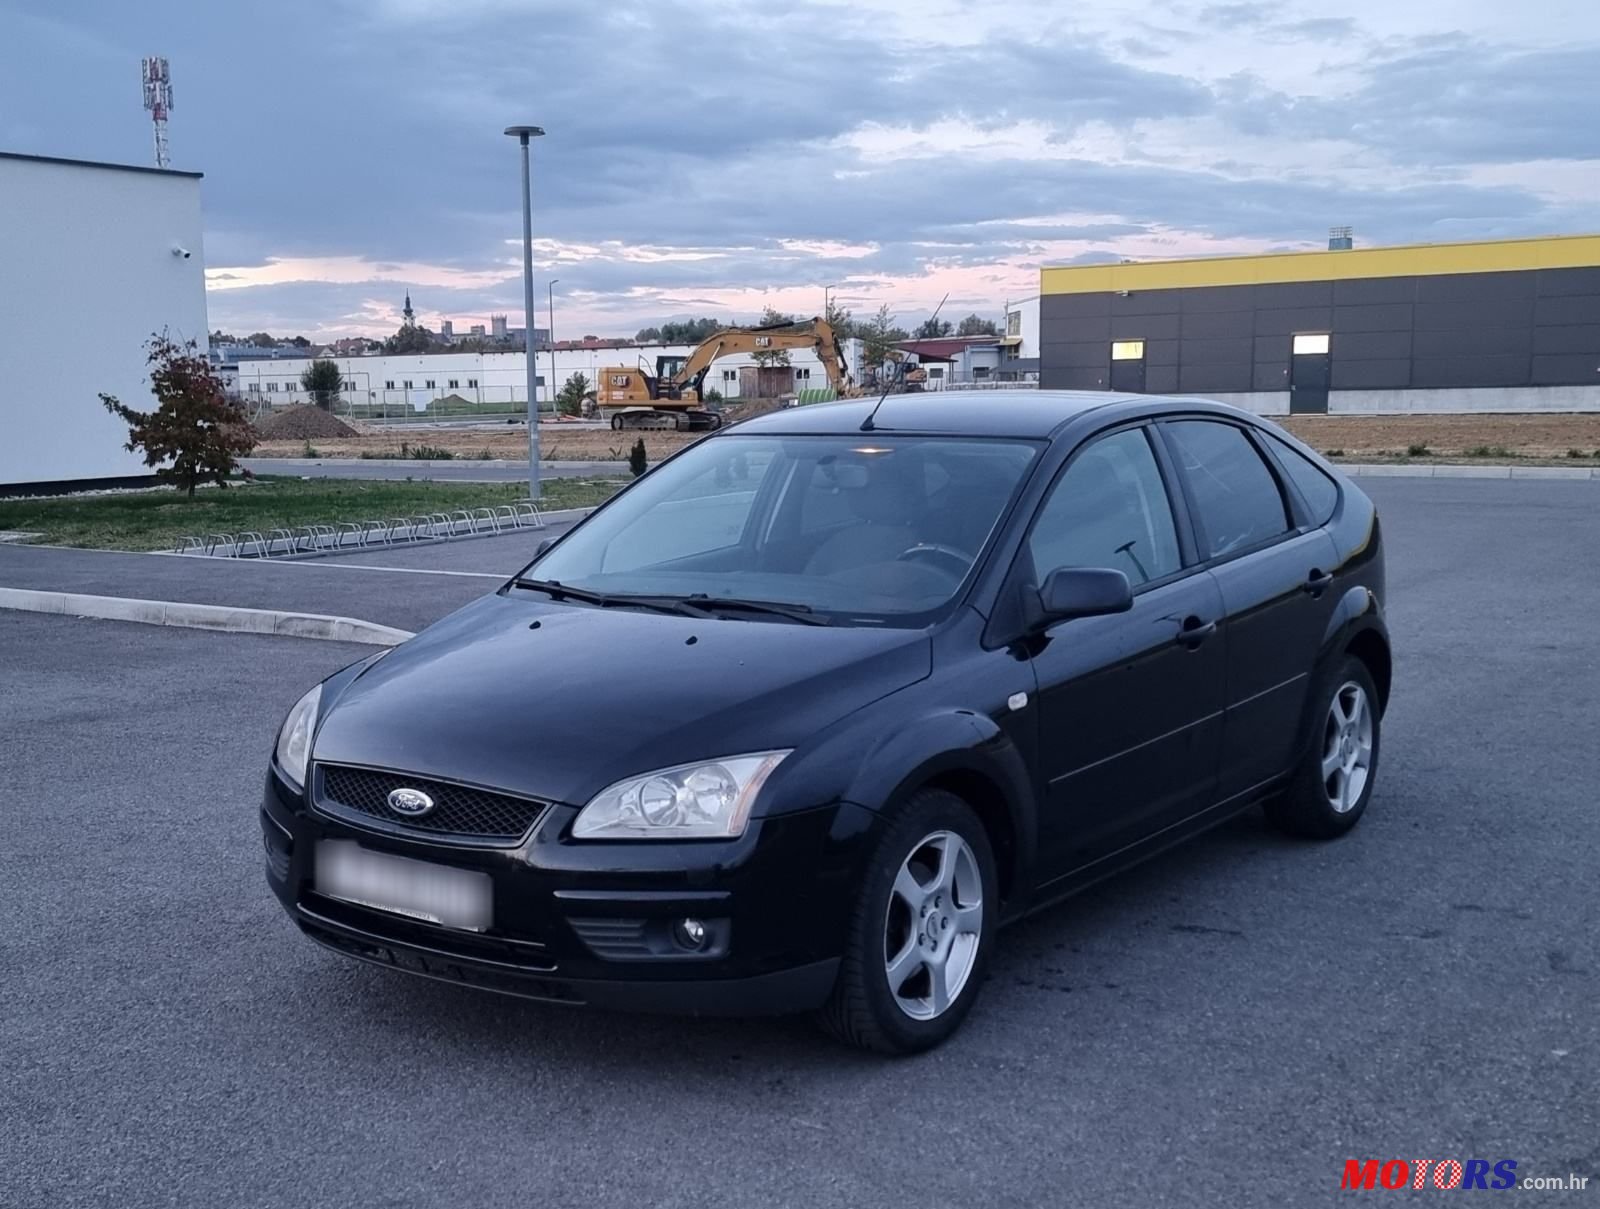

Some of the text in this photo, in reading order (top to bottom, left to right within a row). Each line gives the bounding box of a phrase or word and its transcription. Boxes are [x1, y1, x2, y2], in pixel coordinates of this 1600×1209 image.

[755, 337, 769, 346] CAT
[612, 375, 627, 386] CAT
[395, 793, 420, 810] Ford
